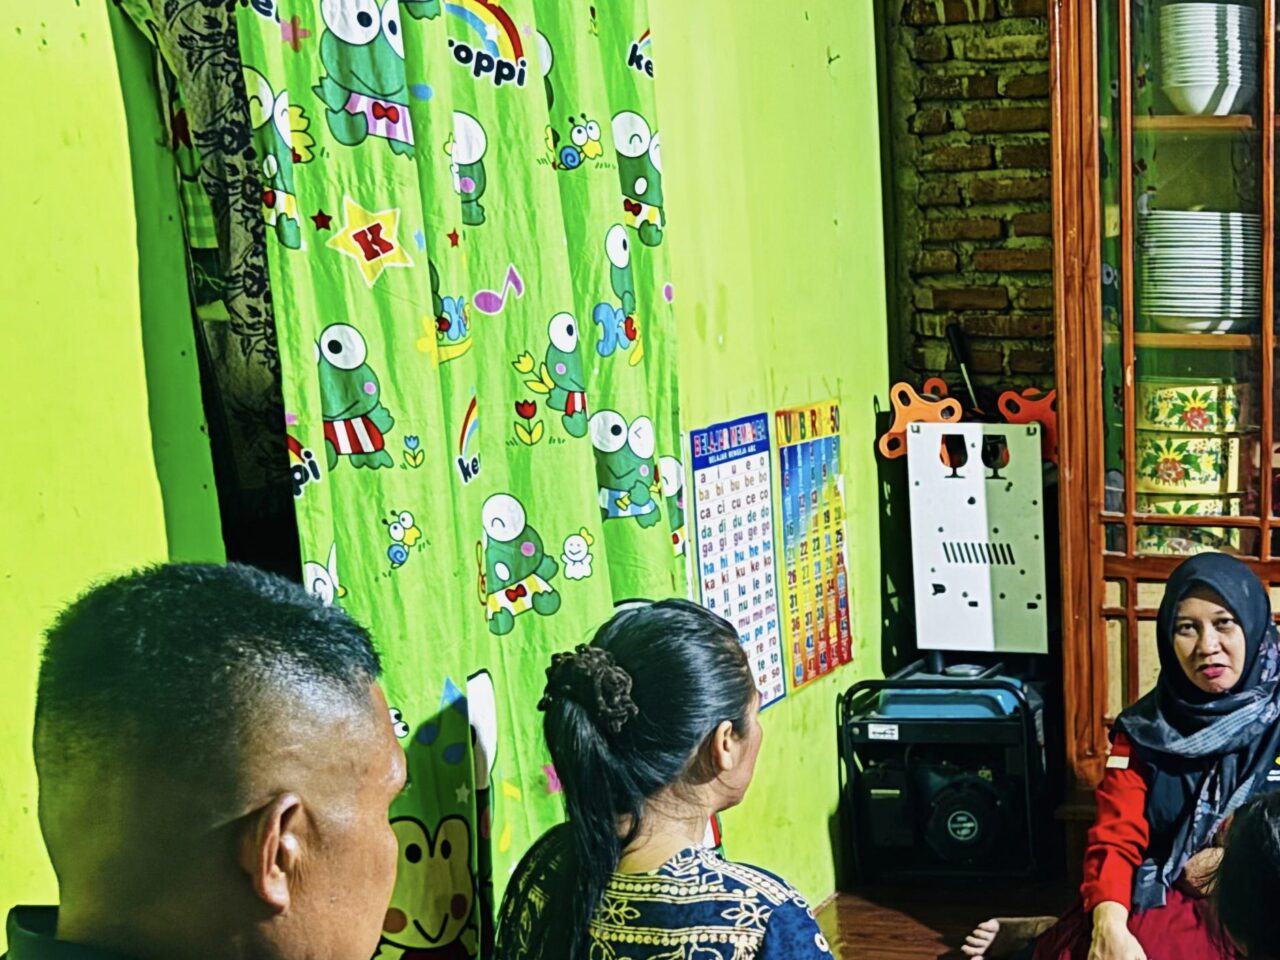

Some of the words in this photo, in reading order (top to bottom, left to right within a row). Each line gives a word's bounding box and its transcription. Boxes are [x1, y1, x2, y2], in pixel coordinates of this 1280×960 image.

[352, 223, 394, 262] K
[290, 450, 320, 496] pi
[458, 457, 479, 483] ke
[715, 483, 724, 496] bi
[730, 479, 740, 492] bu
[744, 474, 754, 487] be
[700, 507, 711, 520] ca
[717, 500, 725, 514] ci
[731, 498, 741, 510] cu
[746, 493, 756, 505] ce
[760, 489, 768, 500] co
[701, 525, 712, 539] da
[718, 519, 726, 533] di
[732, 514, 742, 528] du
[747, 510, 757, 523] de
[761, 505, 769, 518] do
[702, 541, 713, 558] ga
[719, 537, 727, 552] gi
[733, 531, 743, 546] gu
[748, 526, 757, 541] ge
[800, 541, 808, 556] 22
[812, 536, 820, 551] 23
[835, 529, 843, 543] 25
[703, 562, 715, 576] ha
[720, 554, 728, 569] hi
[734, 550, 744, 563] hu
[748, 544, 759, 557] he
[704, 578, 715, 591] ka
[721, 570, 729, 584] ki
[735, 566, 746, 578] ku
[750, 560, 760, 573] ke
[763, 555, 771, 567] ko
[788, 569, 796, 585] 26
[707, 597, 716, 609] la
[738, 583, 746, 597] lu
[723, 604, 732, 618] ni
[738, 600, 748, 613] nu
[752, 594, 762, 606] ne
[765, 588, 773, 600] no
[790, 594, 797, 609] 31
[738, 615, 750, 629] mu
[752, 609, 763, 621] me
[754, 625, 764, 640] pe
[767, 619, 776, 632] po
[756, 643, 764, 654] re
[769, 636, 777, 647] ro
[757, 659, 765, 671] te
[770, 653, 778, 664] to
[758, 674, 767, 685] se
[771, 666, 780, 678] so
